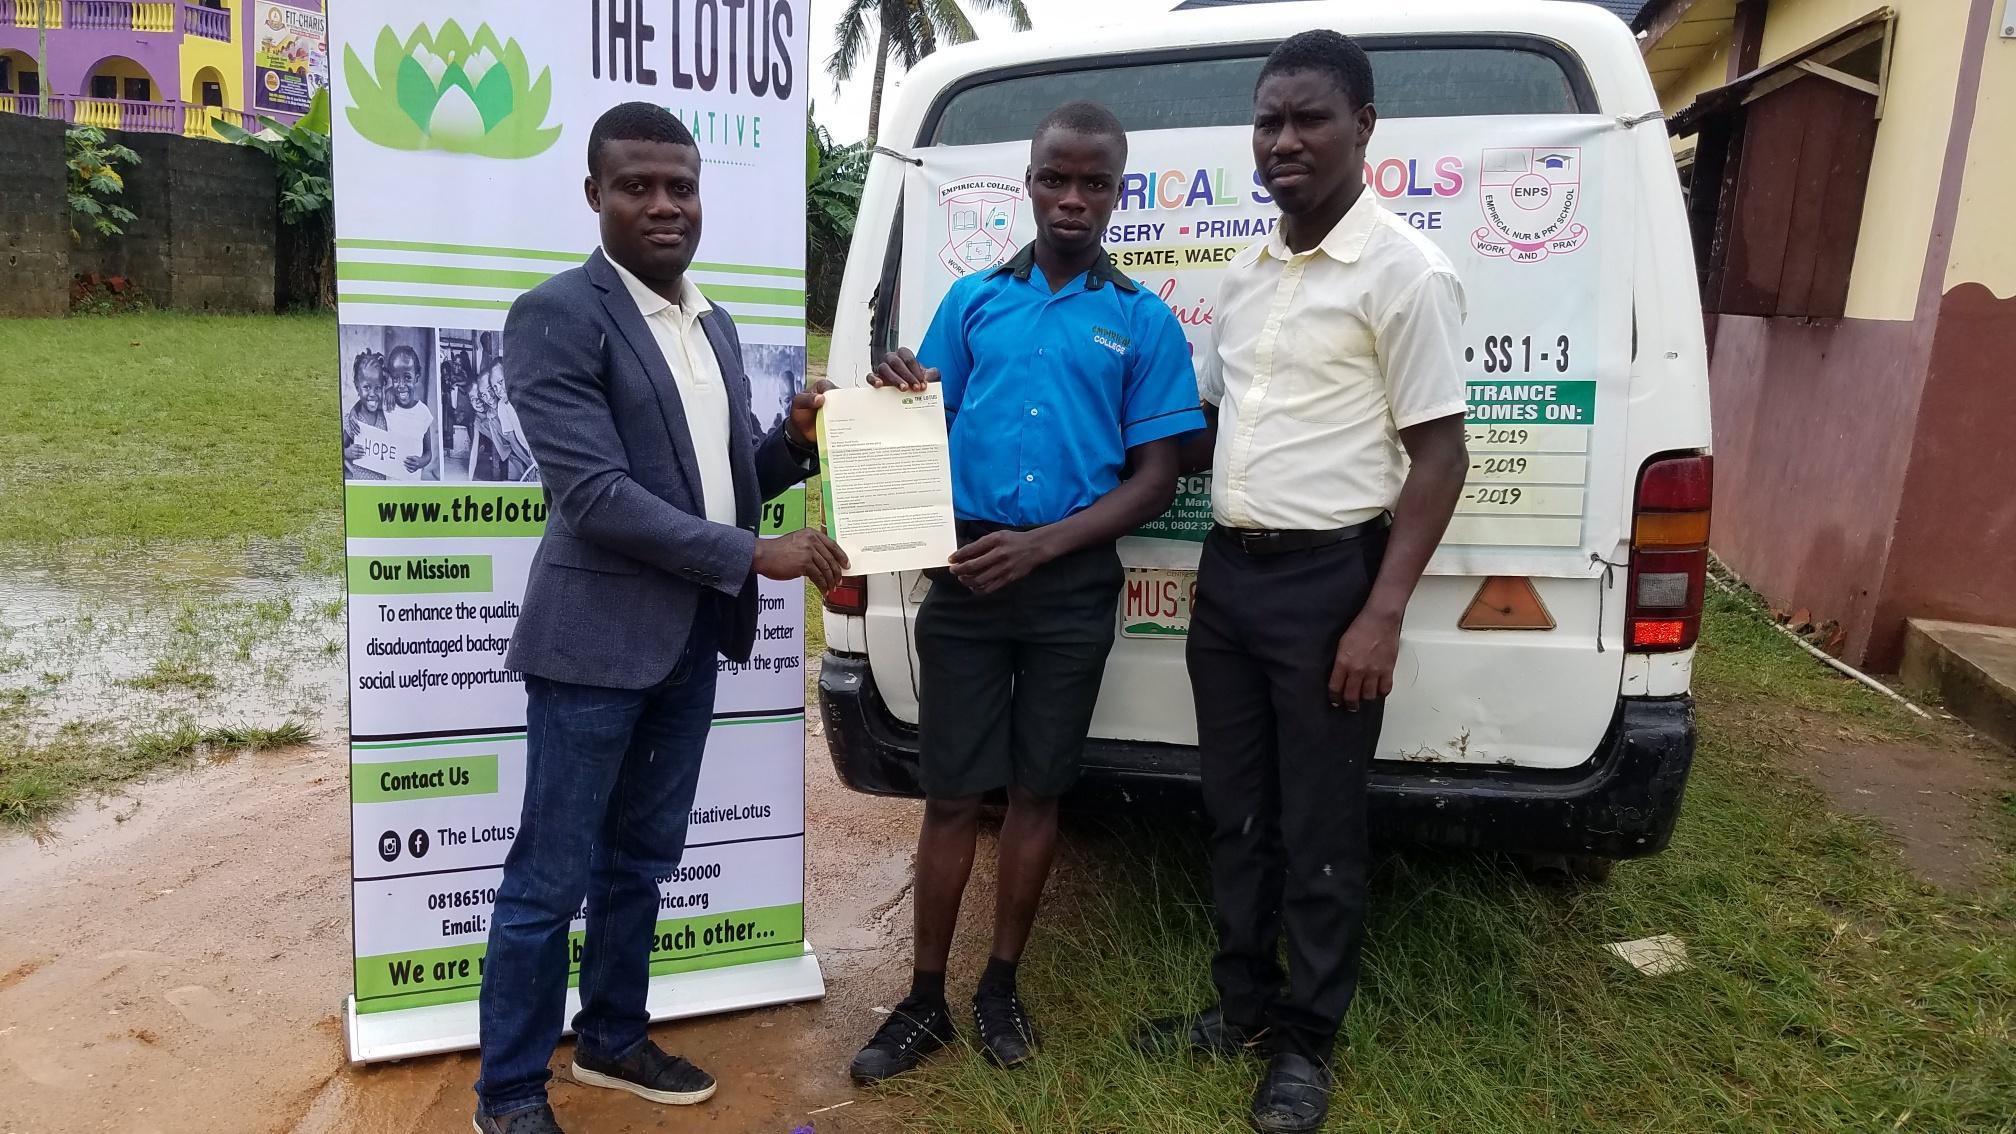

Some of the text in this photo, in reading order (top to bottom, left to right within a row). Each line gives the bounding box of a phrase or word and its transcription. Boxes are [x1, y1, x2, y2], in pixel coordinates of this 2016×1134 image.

[285, 10, 325, 32] FIT-CHARIS
[672, 0, 793, 100] LOTUS
[680, 106, 760, 148] ATIVE
[941, 182, 1021, 197] EMPIRICAL COLLEGE
[1121, 167, 1239, 211] RICAL
[1514, 187, 1549, 197] ENPS
[1485, 194, 1511, 236] EMPIRICAL
[1511, 231, 1532, 241] NUR
[1541, 222, 1559, 238] PRY
[1556, 188, 1575, 225] SCHOOL
[1122, 250, 1179, 267] STATE,
[1185, 247, 1237, 263] WAEC
[1477, 239, 1578, 260] WORK AND PRAY
[948, 258, 966, 276] WORK
[1094, 335, 1126, 355] COLLEGE
[1484, 335, 1512, 373] SS
[1545, 404, 1582, 420] ON:
[364, 438, 397, 460] HOPE
[378, 495, 548, 523] www.thelotu
[369, 559, 471, 581] Our Mission
[379, 604, 396, 622] To
[399, 603, 453, 622] enhance
[455, 602, 477, 619] the
[758, 594, 785, 615] from
[366, 635, 463, 657] disadvantaged
[466, 633, 510, 656] backgr
[763, 624, 794, 641] better
[359, 671, 396, 690] social
[399, 669, 449, 691] welfare
[753, 653, 771, 671] the
[773, 656, 800, 674] grass
[380, 767, 470, 792] Contact Us
[438, 827, 467, 846] The
[472, 825, 515, 843] Lotus
[442, 915, 487, 937] Email:
[388, 959, 424, 987] We
[433, 955, 470, 981] are
[703, 919, 775, 946] other...
